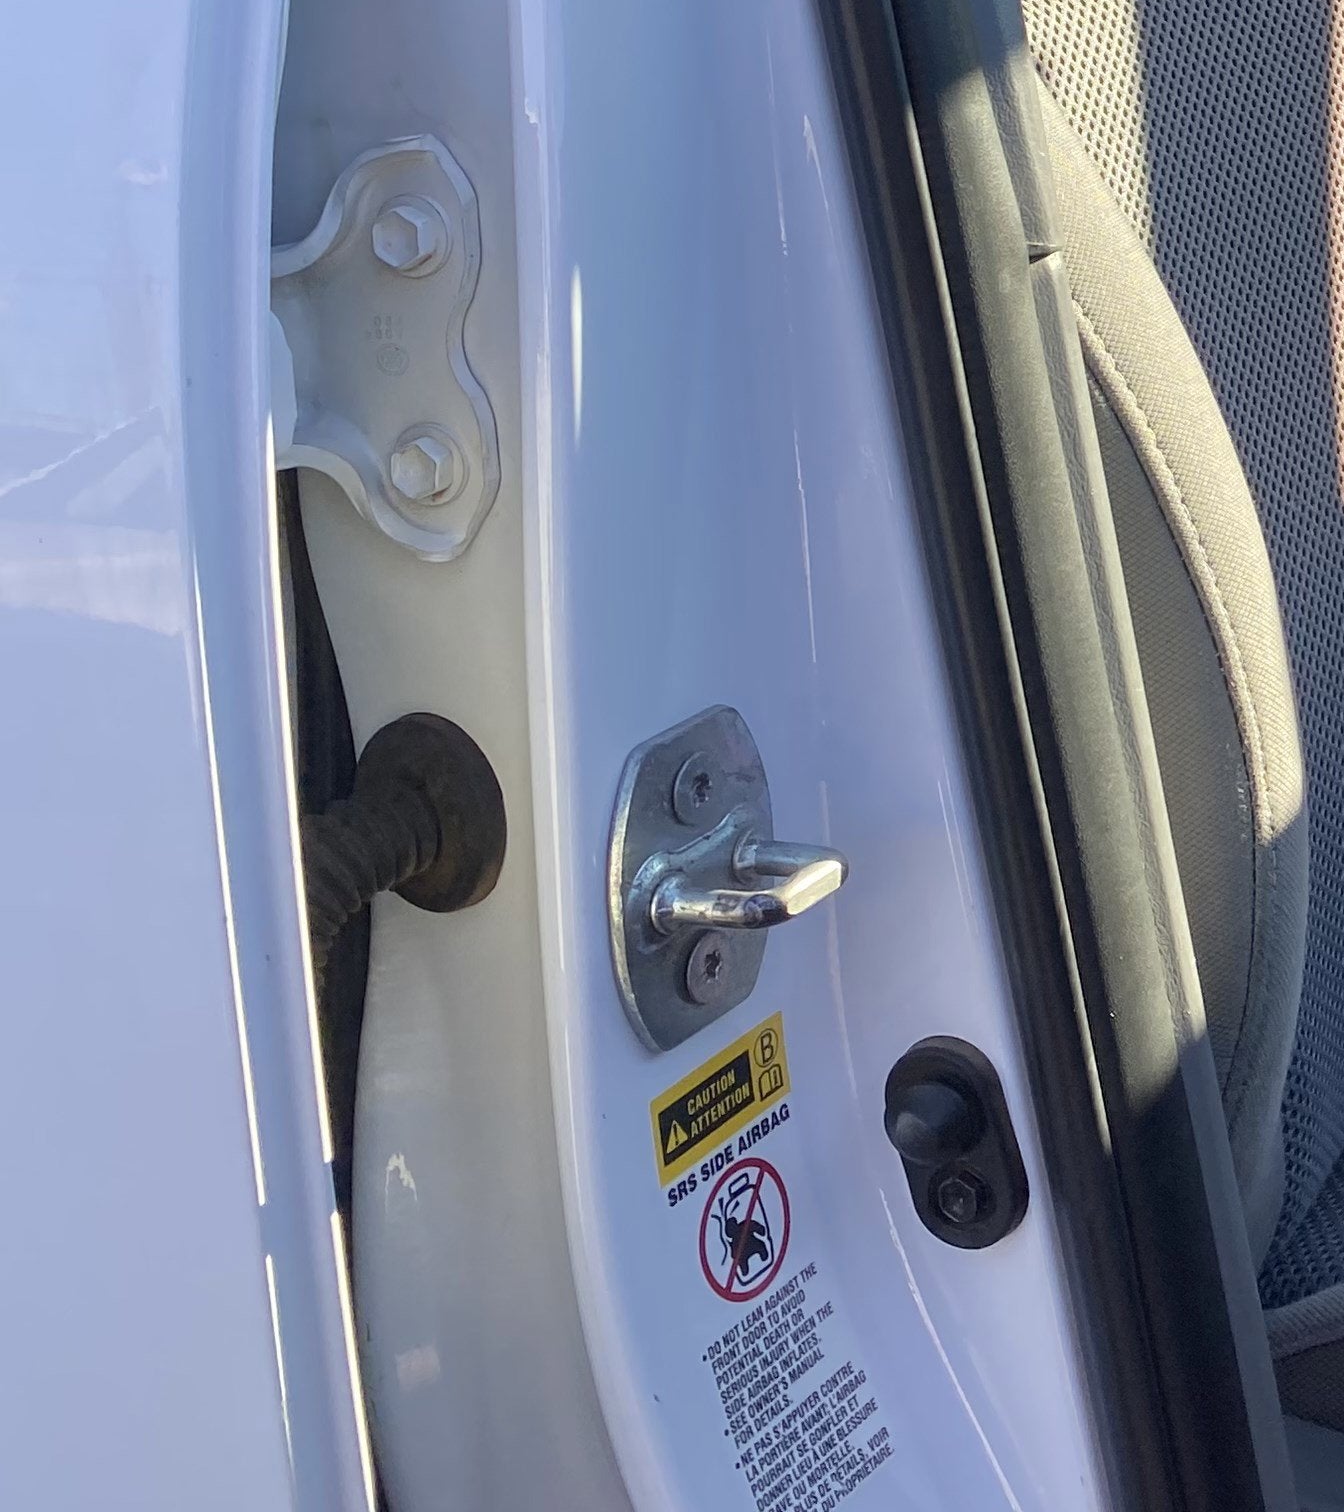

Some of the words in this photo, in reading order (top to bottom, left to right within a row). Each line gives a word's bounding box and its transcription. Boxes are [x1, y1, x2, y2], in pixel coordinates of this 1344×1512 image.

[686, 1068, 736, 1116] CAUTION
[760, 1031, 774, 1065] B
[690, 1081, 750, 1139] ATTENTION
[667, 1173, 698, 1208] SRS
[700, 1145, 735, 1182] SIDE
[738, 1103, 791, 1156] AIRBAG
[707, 1340, 722, 1360] DO
[722, 1324, 740, 1348] NOT
[741, 1305, 764, 1332] LEAN
[764, 1275, 800, 1312] AGAINST
[799, 1261, 818, 1284] THE
[711, 1342, 741, 1376] FRONT
[741, 1321, 768, 1351] DOOR
[767, 1310, 780, 1329] TO
[781, 1289, 806, 1319] AVOID
[715, 1343, 764, 1391] POTENTIAL
[762, 1321, 791, 1351] DEATH
[791, 1308, 805, 1327] OR
[720, 1364, 759, 1405] SERIOUS
[759, 1336, 790, 1372] INJURY
[789, 1315, 817, 1345] WHEN
[816, 1300, 834, 1324] THE
[724, 1392, 747, 1420] SIDE
[747, 1365, 780, 1402] AIRBAG
[778, 1332, 822, 1373] INFLATES.
[729, 1410, 748, 1435] SEE
[747, 1376, 789, 1419] OWNER'S
[788, 1346, 825, 1385] MANUAL
[740, 1447, 755, 1468] NE
[753, 1431, 773, 1456] PAS
[772, 1390, 821, 1440] S'APPUYER
[819, 1360, 855, 1398] CONTRE
[734, 1424, 755, 1450] FOR
[753, 1394, 793, 1433] DETAILS.
[745, 1463, 760, 1483] LA
[828, 1369, 867, 1410] L'AIRBAG
[750, 1449, 796, 1498] POURRAIT
[796, 1438, 810, 1458] SE
[808, 1405, 849, 1447] GONFLER
[847, 1393, 860, 1413] ET
[756, 1473, 794, 1512] DONNER
[791, 1455, 813, 1481] LIEU
[818, 1433, 838, 1458] UNE
[836, 1396, 879, 1442] BLESSURE
[817, 1477, 832, 1498] DE
[866, 1426, 890, 1452] VOIR
[792, 1479, 808, 1500] OU
